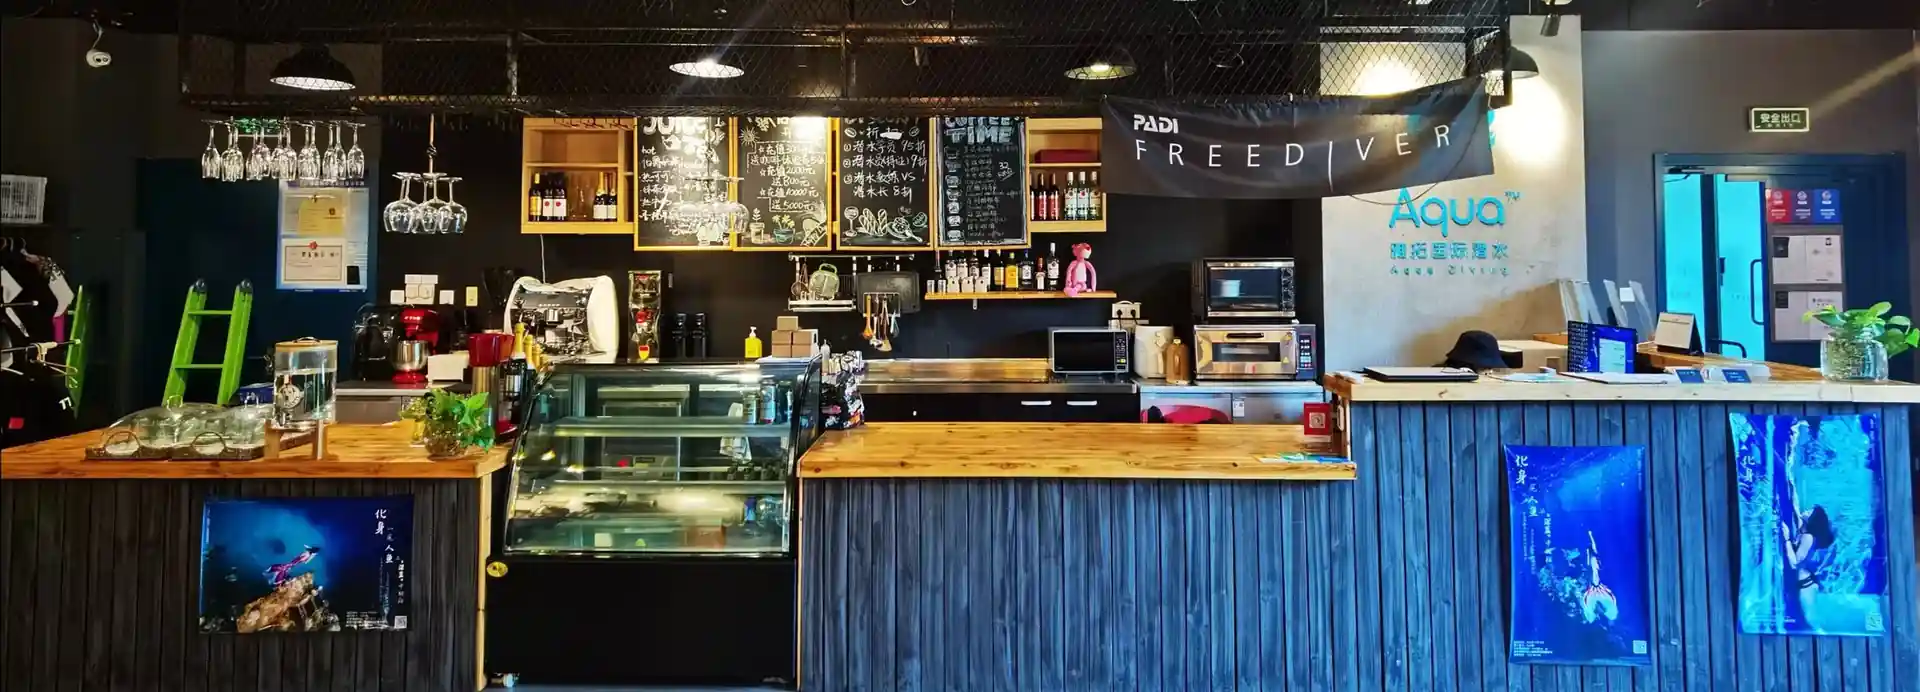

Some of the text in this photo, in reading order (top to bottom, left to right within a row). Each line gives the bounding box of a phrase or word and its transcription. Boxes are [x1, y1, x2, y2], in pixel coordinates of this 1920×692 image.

[1133, 114, 1179, 134] PADI
[1760, 112, 1801, 123] 安全出口
[944, 126, 1015, 144] TIME
[642, 146, 656, 155] hot
[901, 173, 916, 181] VS
[1388, 187, 1507, 238] Aqua
[1515, 454, 1529, 485] 化身
[374, 509, 387, 535] 化身
